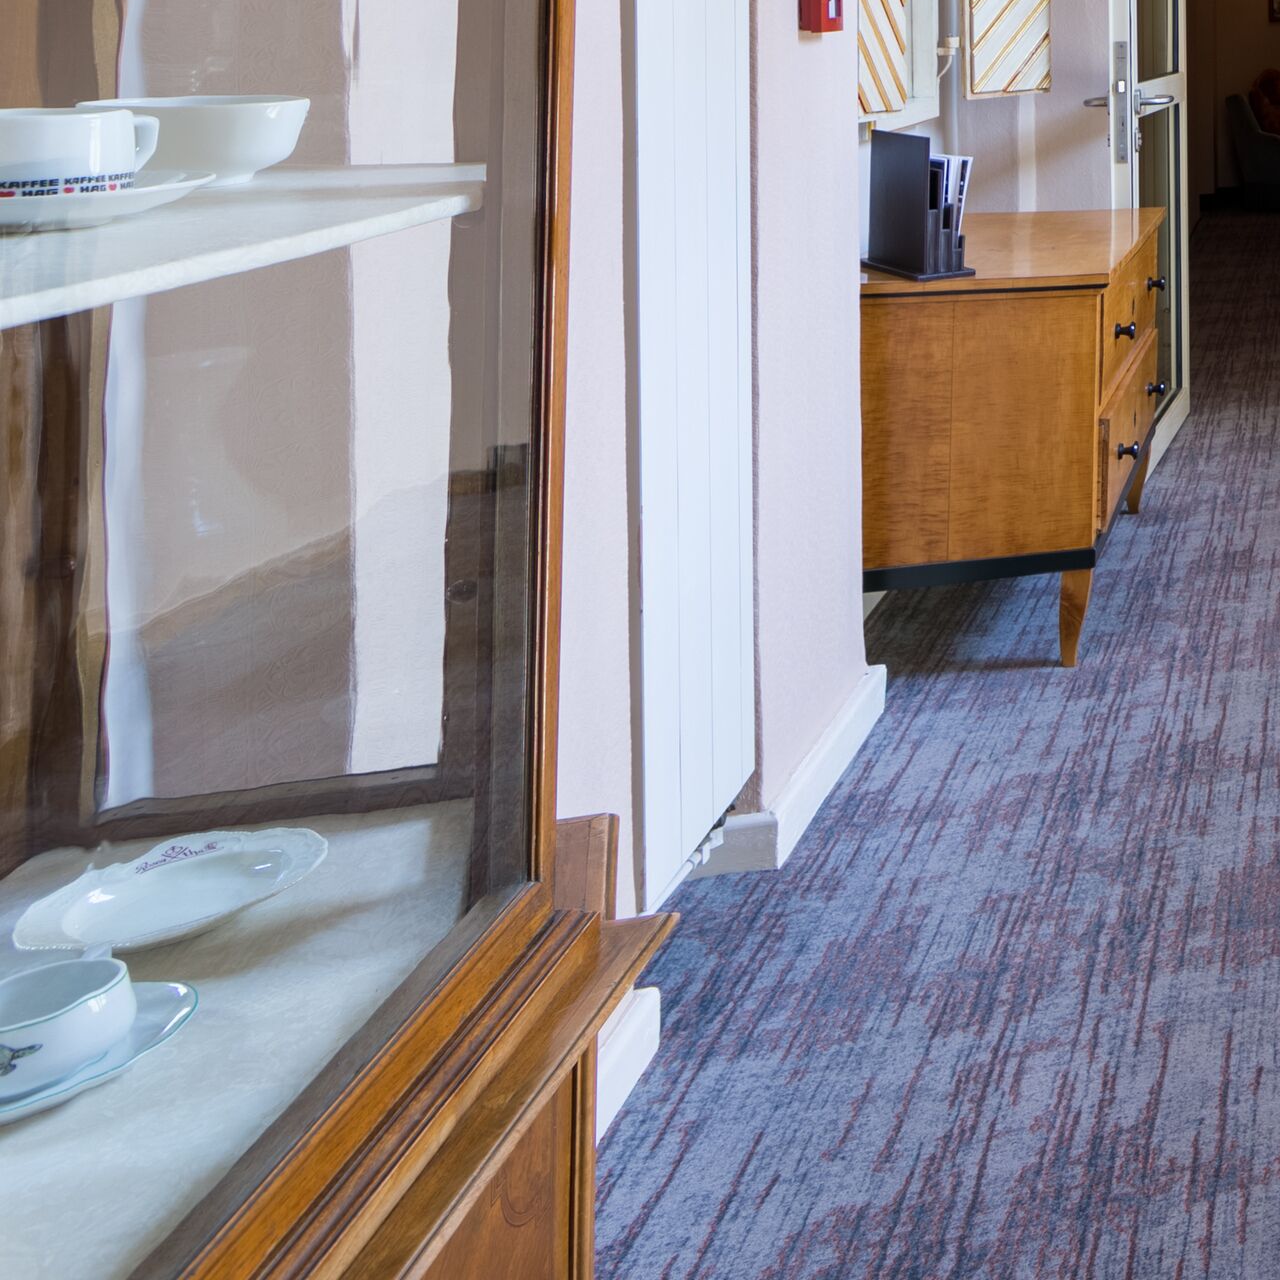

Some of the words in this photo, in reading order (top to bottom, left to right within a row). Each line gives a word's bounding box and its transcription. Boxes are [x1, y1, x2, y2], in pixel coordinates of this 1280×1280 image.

[64, 175, 107, 185] KAFFEE
[21, 188, 59, 197] HAG
[80, 184, 107, 193] HAG
